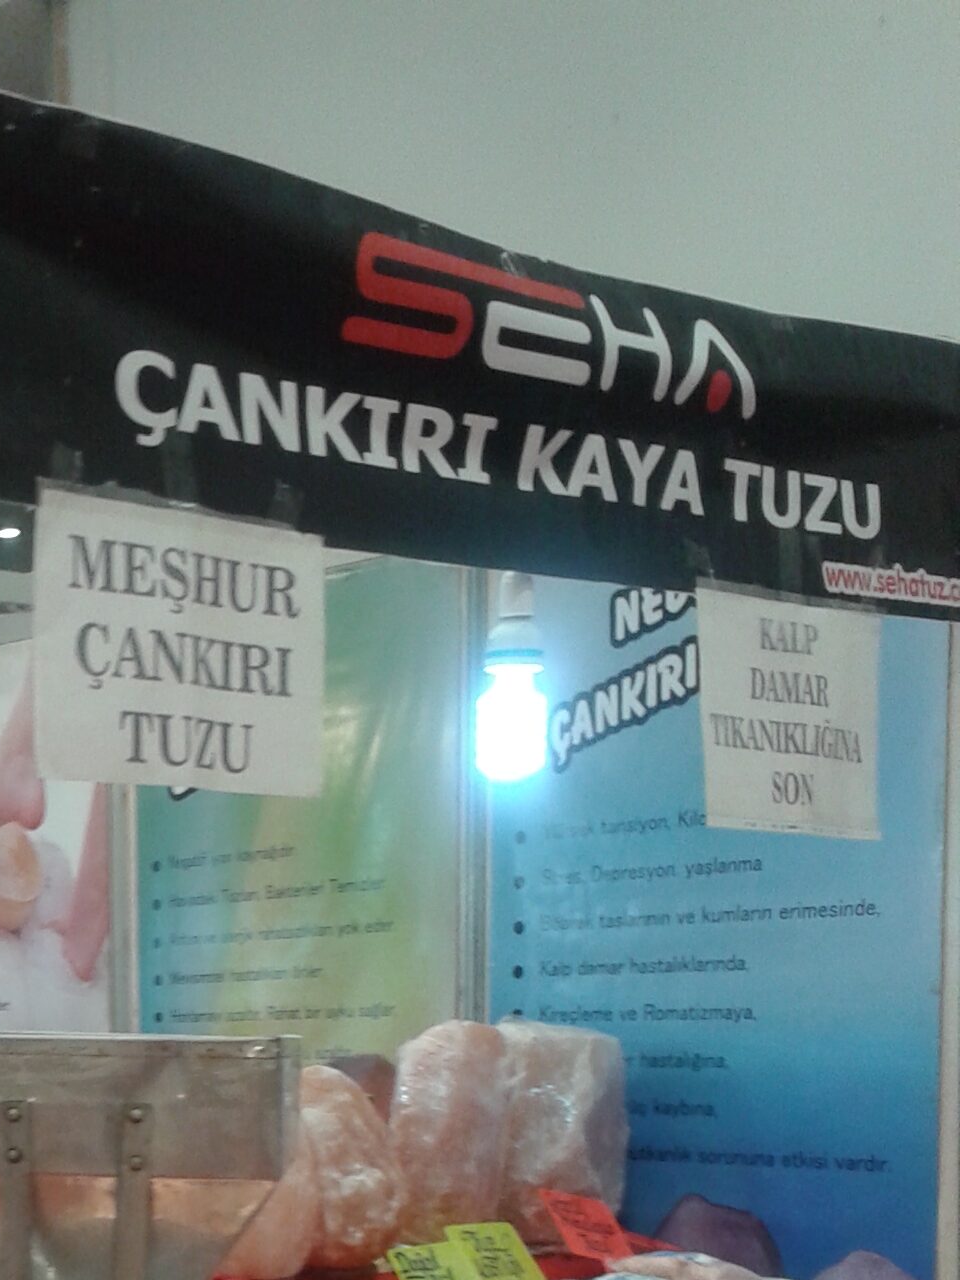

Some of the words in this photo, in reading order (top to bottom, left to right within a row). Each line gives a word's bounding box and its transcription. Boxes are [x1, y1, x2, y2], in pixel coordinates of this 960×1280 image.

[342, 231, 756, 420] SEHA
[114, 349, 498, 485] ÇANKIRI
[516, 423, 705, 516] KAYA
[723, 457, 882, 540] TUZU
[67, 533, 301, 619] MEŞHUR
[75, 621, 294, 698] ÇANKIRI
[759, 617, 819, 656] KALP
[550, 635, 700, 773] ÇANKIRI
[750, 667, 830, 708] DAMAR
[118, 710, 254, 774] TUZU
[771, 771, 815, 806] SON
[683, 856, 763, 880] yaşlanma
